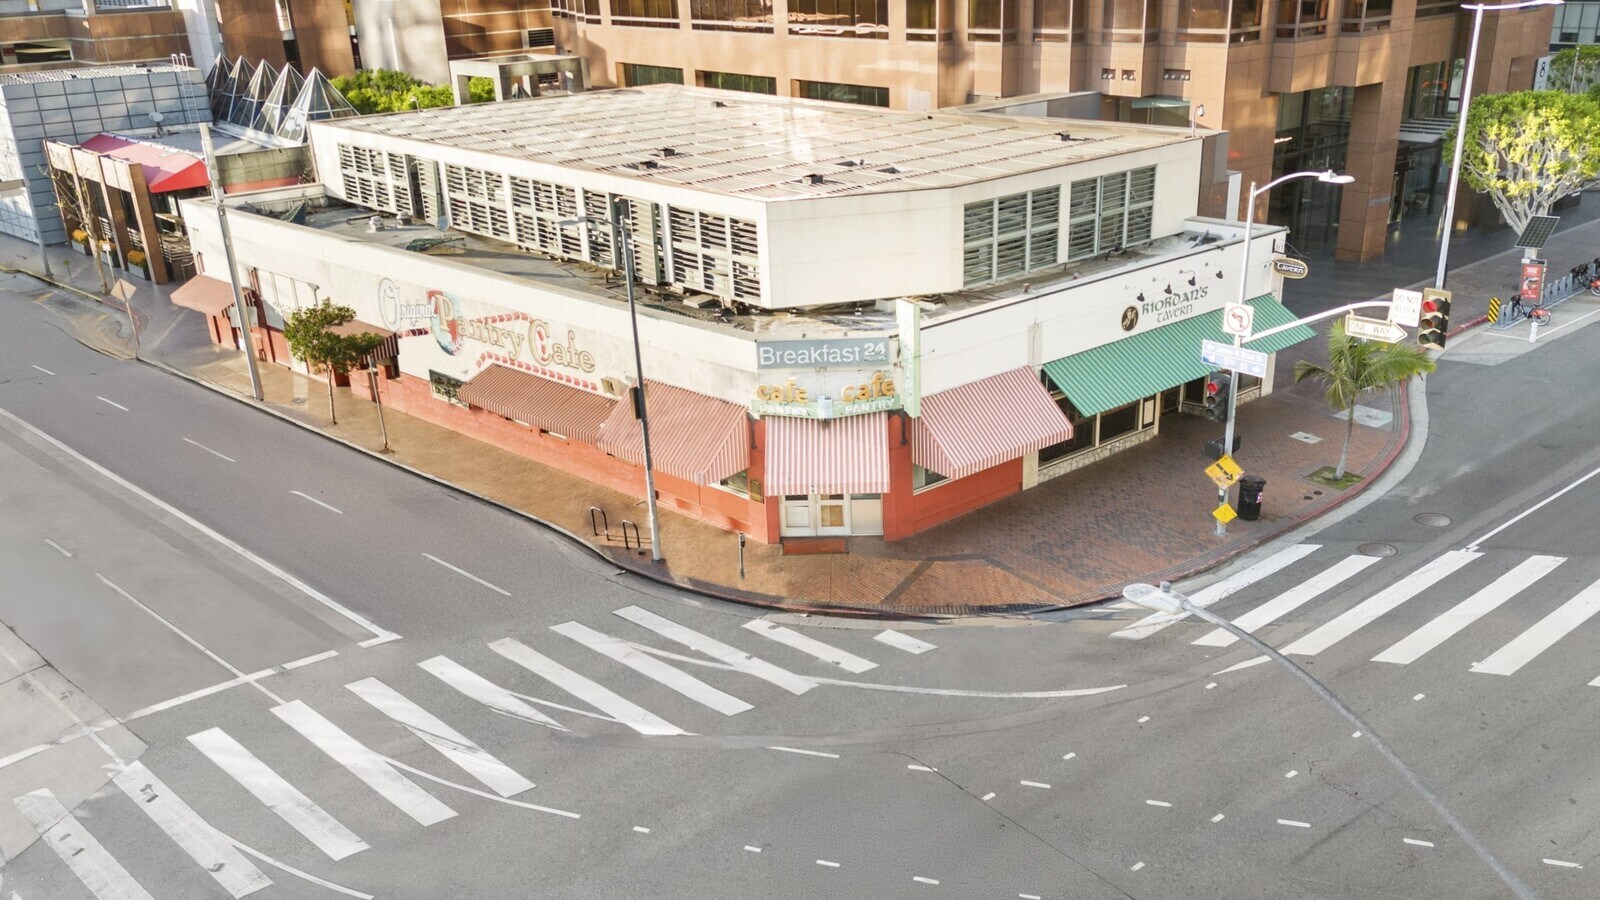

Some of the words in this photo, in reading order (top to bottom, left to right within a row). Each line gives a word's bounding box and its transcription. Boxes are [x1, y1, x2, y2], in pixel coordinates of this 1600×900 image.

[1142, 286, 1209, 315] RIORDAN'S
[378, 277, 438, 332] Original
[437, 294, 525, 360] Pantry
[529, 318, 596, 373] Cafe
[1350, 321, 1366, 332] ONE
[1372, 325, 1391, 336] WAY
[759, 344, 861, 366] Breakfast
[863, 342, 887, 356] 24
[845, 399, 894, 414] PANTRY
